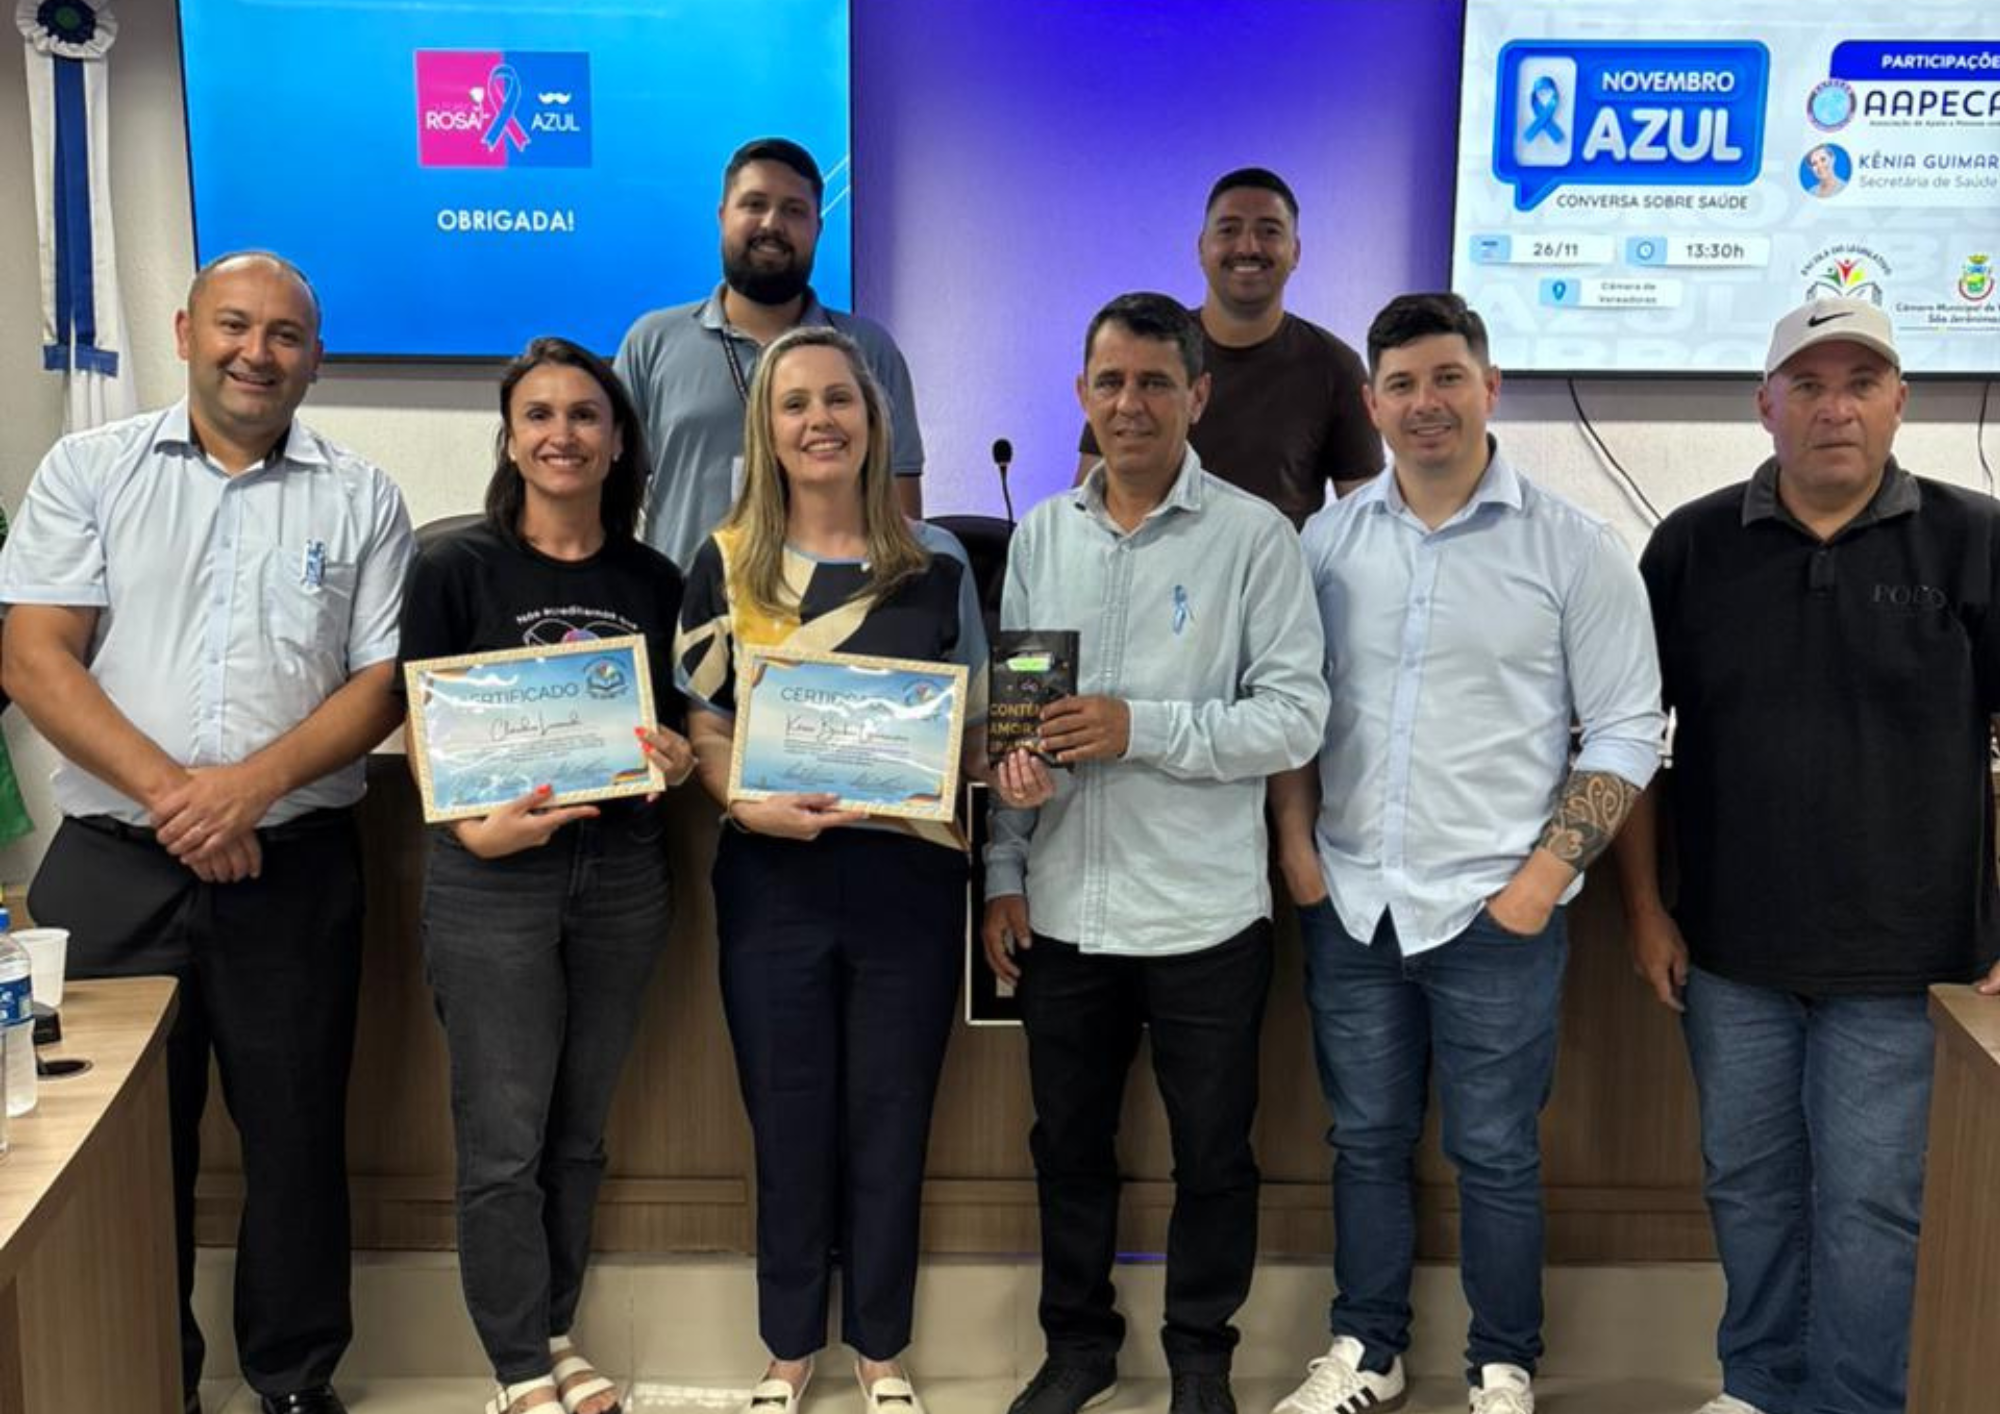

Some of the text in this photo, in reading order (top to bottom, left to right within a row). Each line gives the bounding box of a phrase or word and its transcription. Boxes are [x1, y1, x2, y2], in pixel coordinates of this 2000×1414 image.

[1602, 71, 1735, 92] NOVEMBRO
[426, 111, 482, 130] ROSA
[531, 113, 580, 131] AZUL
[1582, 107, 1743, 162] AZUL
[1859, 151, 1916, 169] KÊNIA
[1859, 174, 1997, 188] Secretária de Saúde
[1556, 193, 1748, 209] CONVERSA SOBRE SAÚDE
[437, 210, 575, 231] OBRIGADA!
[1533, 242, 1579, 258] 26/11
[1686, 243, 1745, 259] 13:30h
